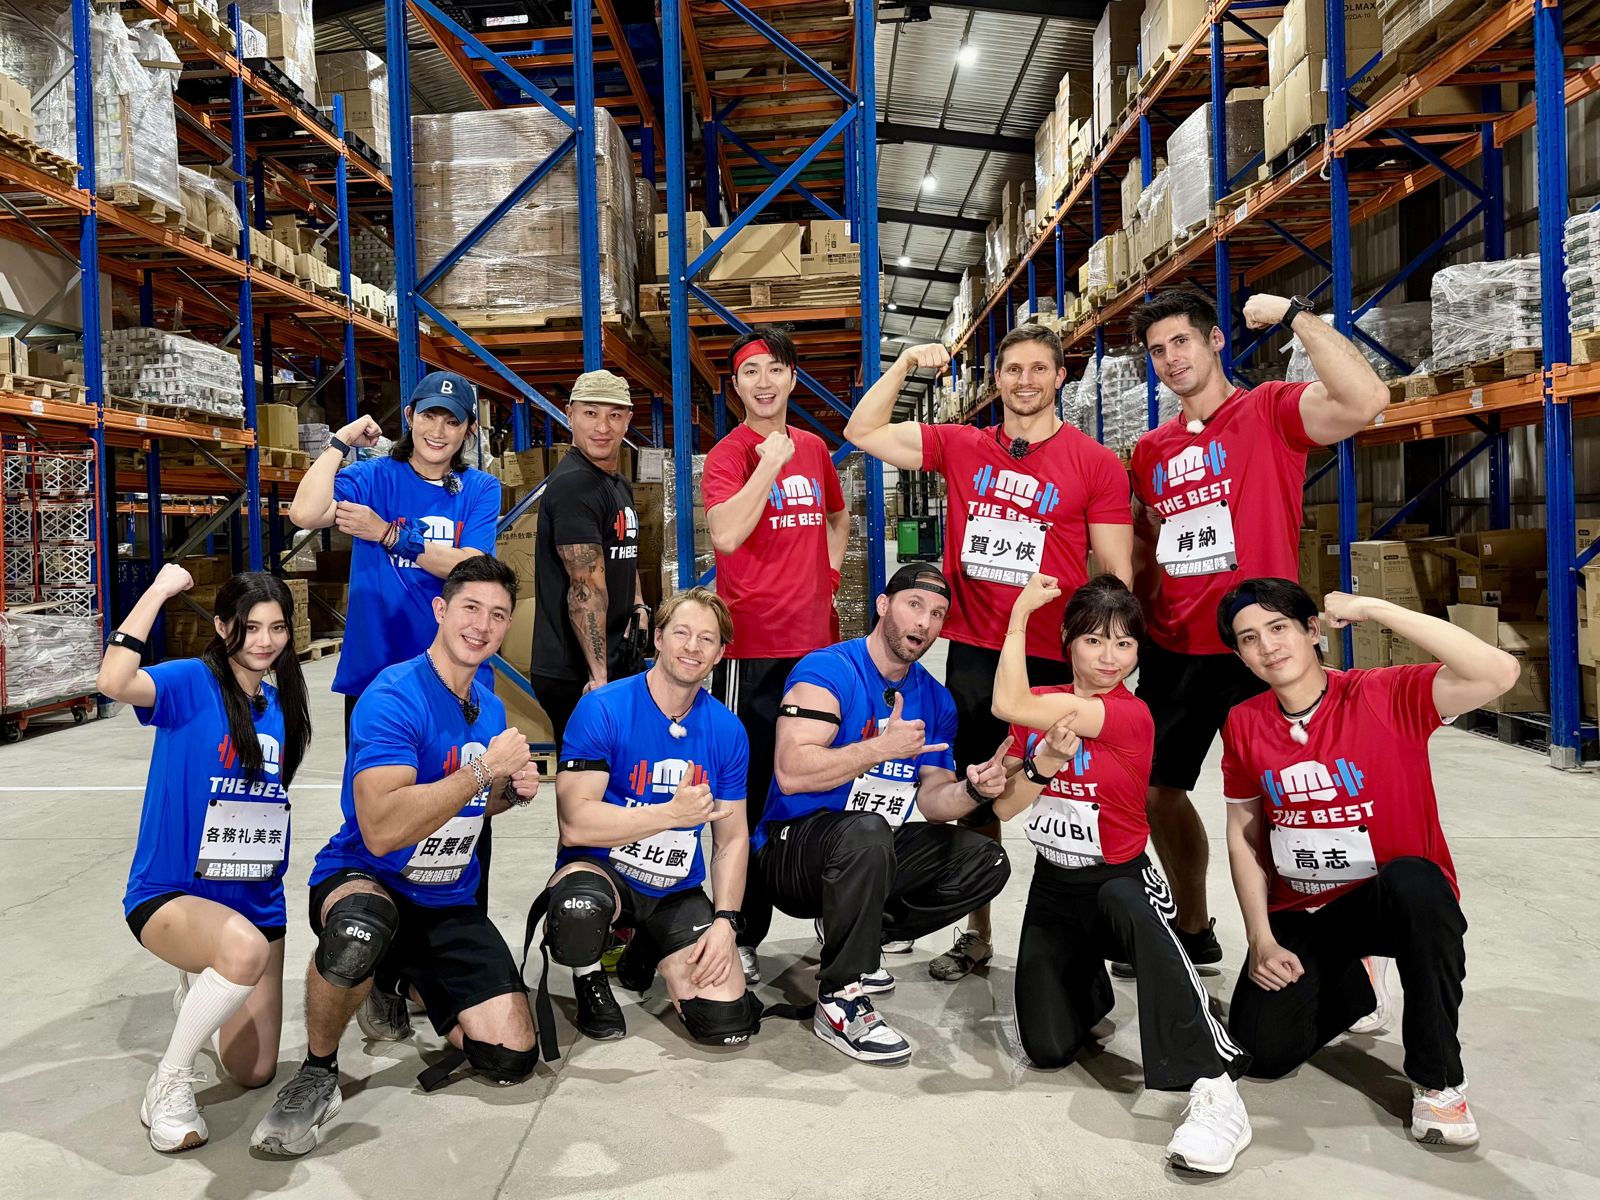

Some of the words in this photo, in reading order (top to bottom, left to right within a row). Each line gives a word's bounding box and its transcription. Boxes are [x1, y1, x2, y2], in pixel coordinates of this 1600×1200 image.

[441, 380, 453, 394] B
[1153, 495, 1187, 515] THE
[1186, 479, 1232, 506] BEST
[968, 501, 1003, 518] THE
[769, 515, 797, 530] THE
[968, 535, 1036, 562] 賀少俠
[1177, 526, 1217, 552] 肯納
[209, 776, 248, 795] THE
[1050, 777, 1098, 797] BEST
[851, 790, 906, 816] 柯子培
[1272, 809, 1308, 826] THE
[1310, 800, 1374, 824] BEST
[206, 827, 282, 844] 各務礼美奈
[1029, 815, 1093, 843] JJUBI
[620, 841, 688, 867] 法比歐
[1292, 848, 1351, 870] 高志
[564, 897, 592, 910] elos
[346, 926, 372, 942] elos
